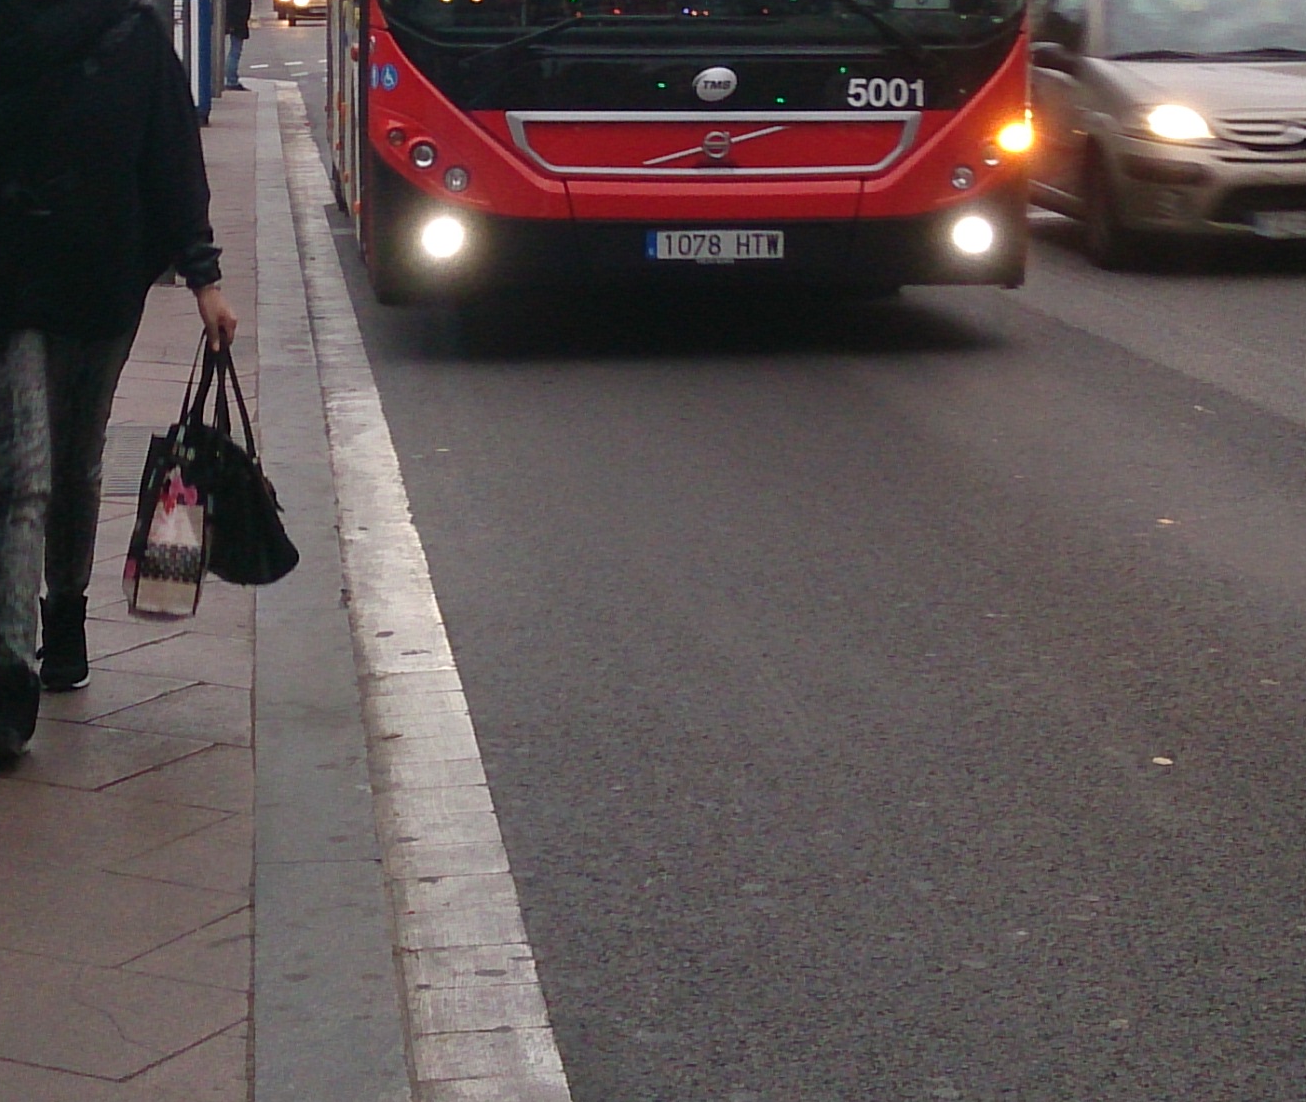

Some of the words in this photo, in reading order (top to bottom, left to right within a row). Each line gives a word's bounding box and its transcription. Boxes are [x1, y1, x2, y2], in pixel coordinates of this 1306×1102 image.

[846, 77, 925, 108] 5001
[665, 234, 722, 256] 1078
[736, 233, 780, 256] HTW
